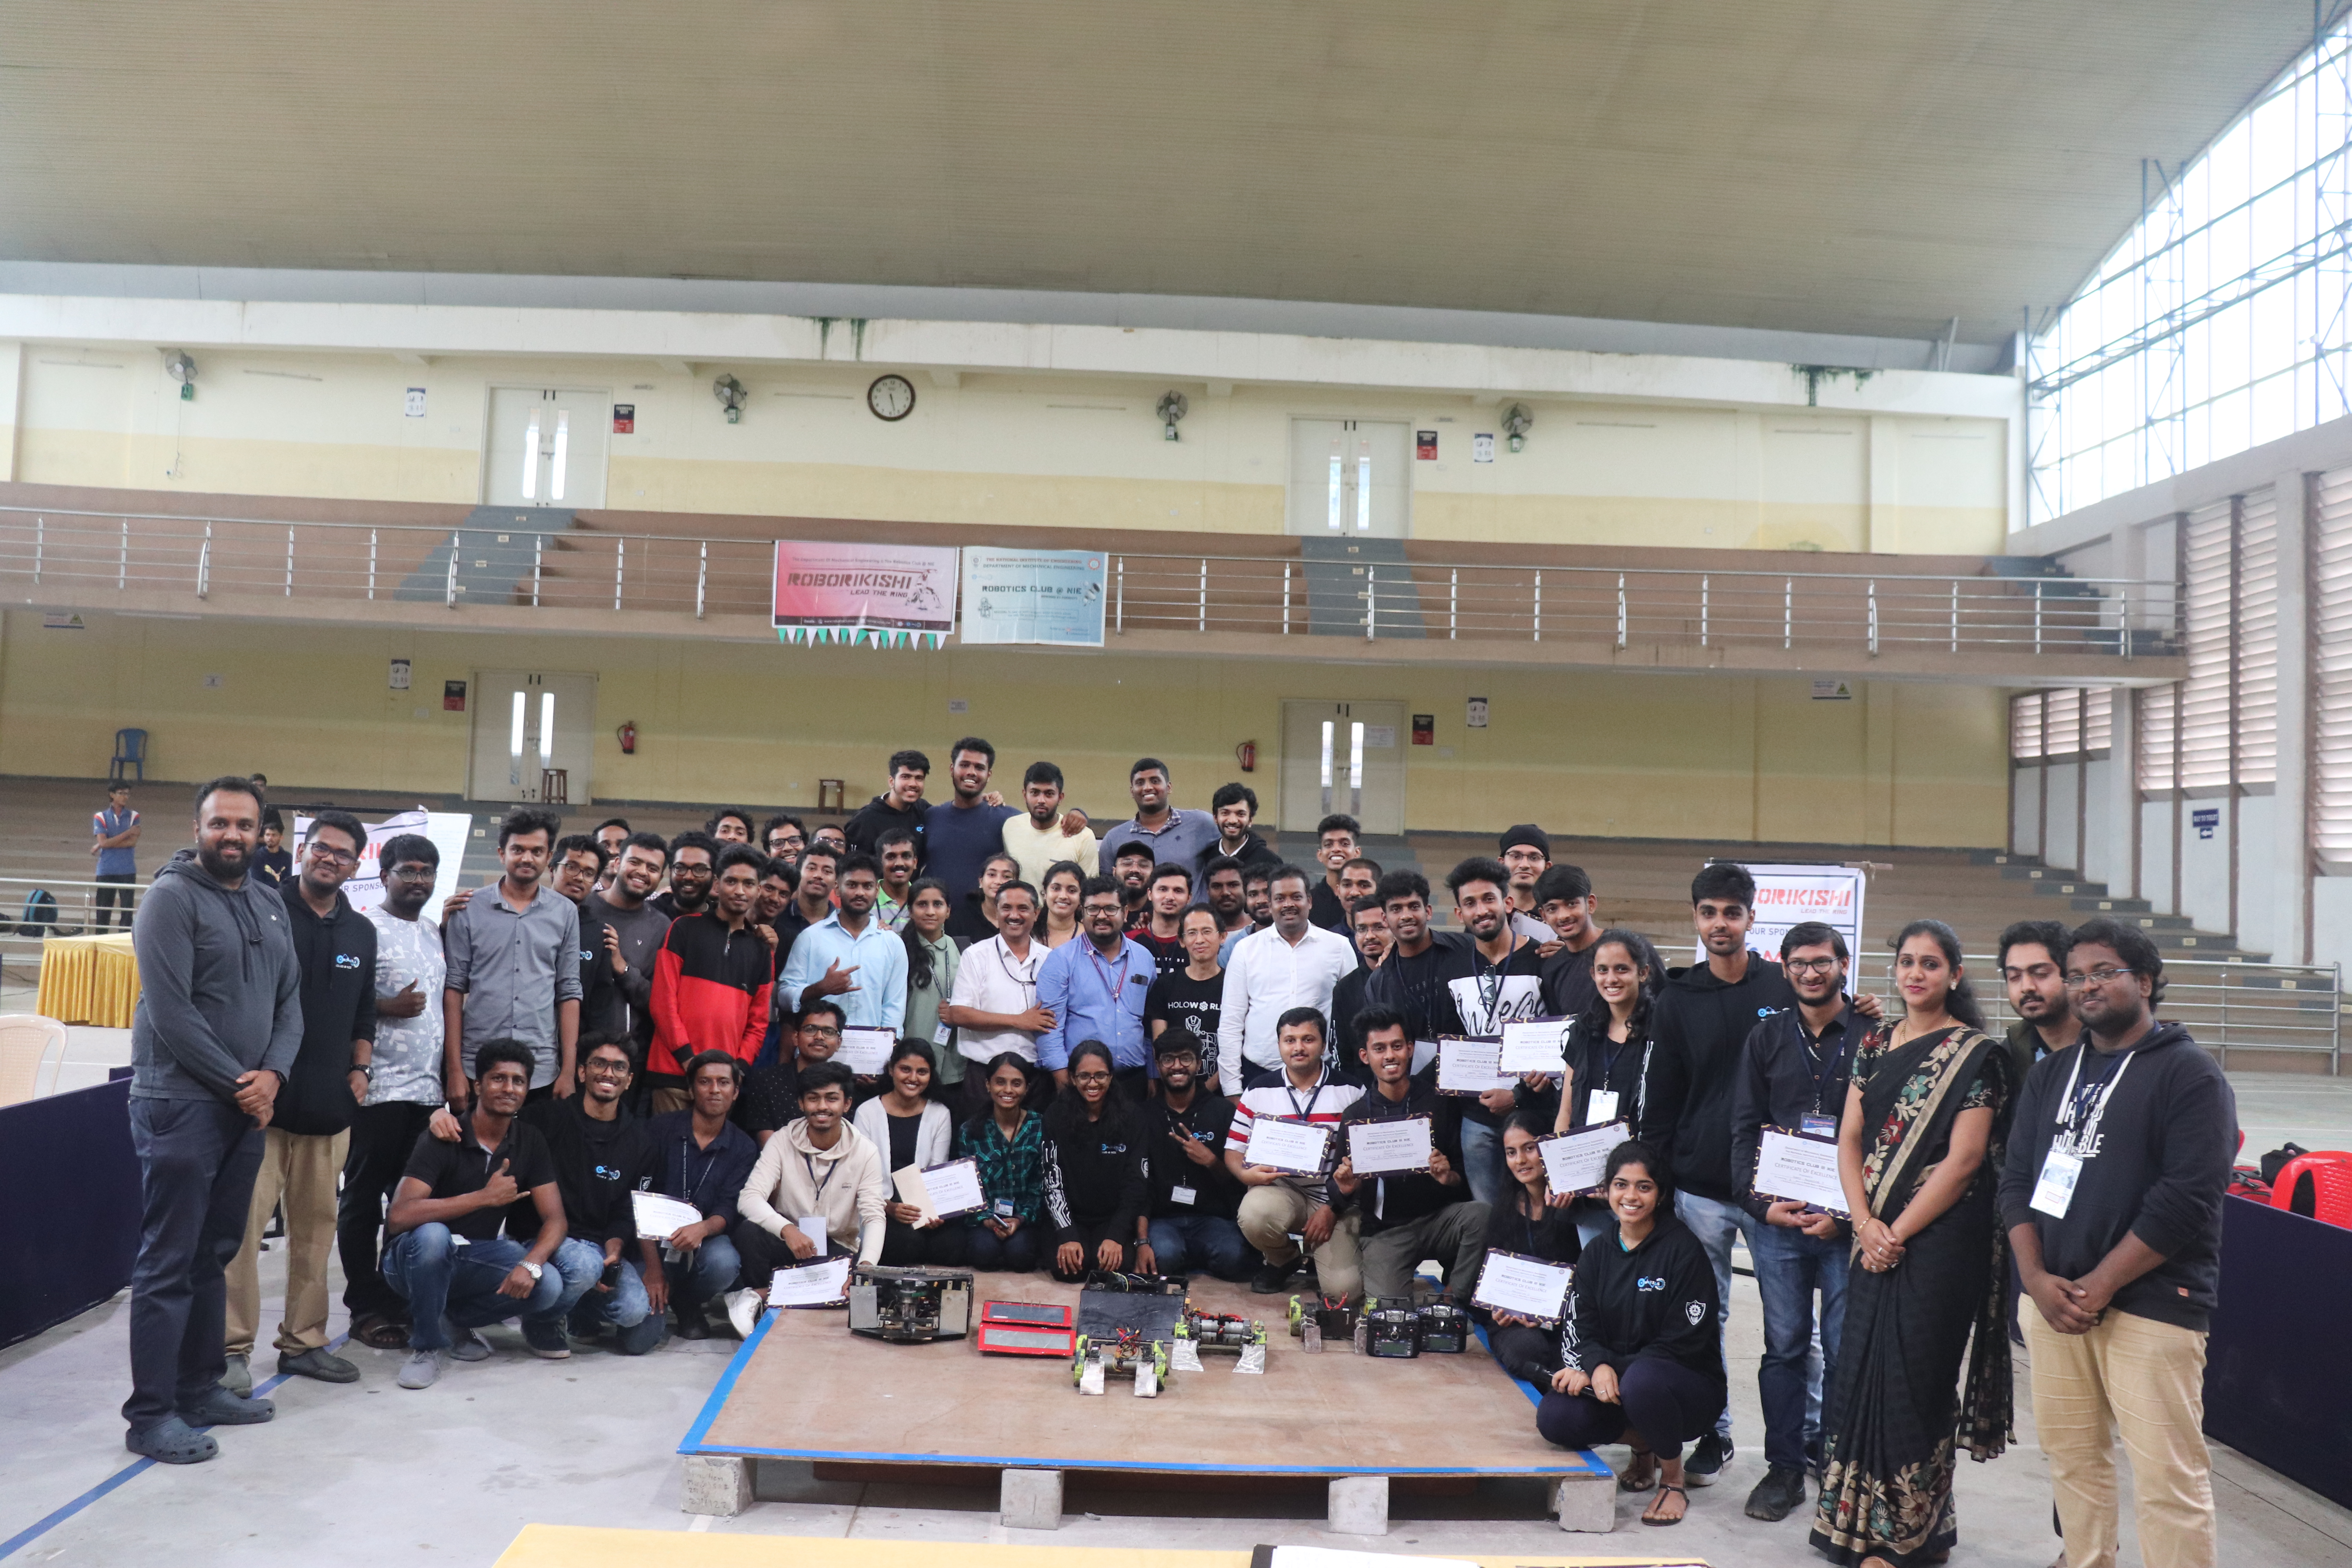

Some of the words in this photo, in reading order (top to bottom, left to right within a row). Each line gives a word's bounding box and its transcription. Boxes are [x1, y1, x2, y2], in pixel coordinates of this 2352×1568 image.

[787, 573, 913, 589] ROBORIKISHI
[1560, 1160, 1584, 1168] CERTIFICATE
[1780, 1157, 1806, 1166] ROBOTICS
[1775, 1162, 1802, 1173] CERTIFICATE
[1811, 1170, 1838, 1181] EXCELLENCE
[1495, 1278, 1519, 1287] CERTIFICATE
[1525, 1285, 1548, 1293] EXCELLENCE
